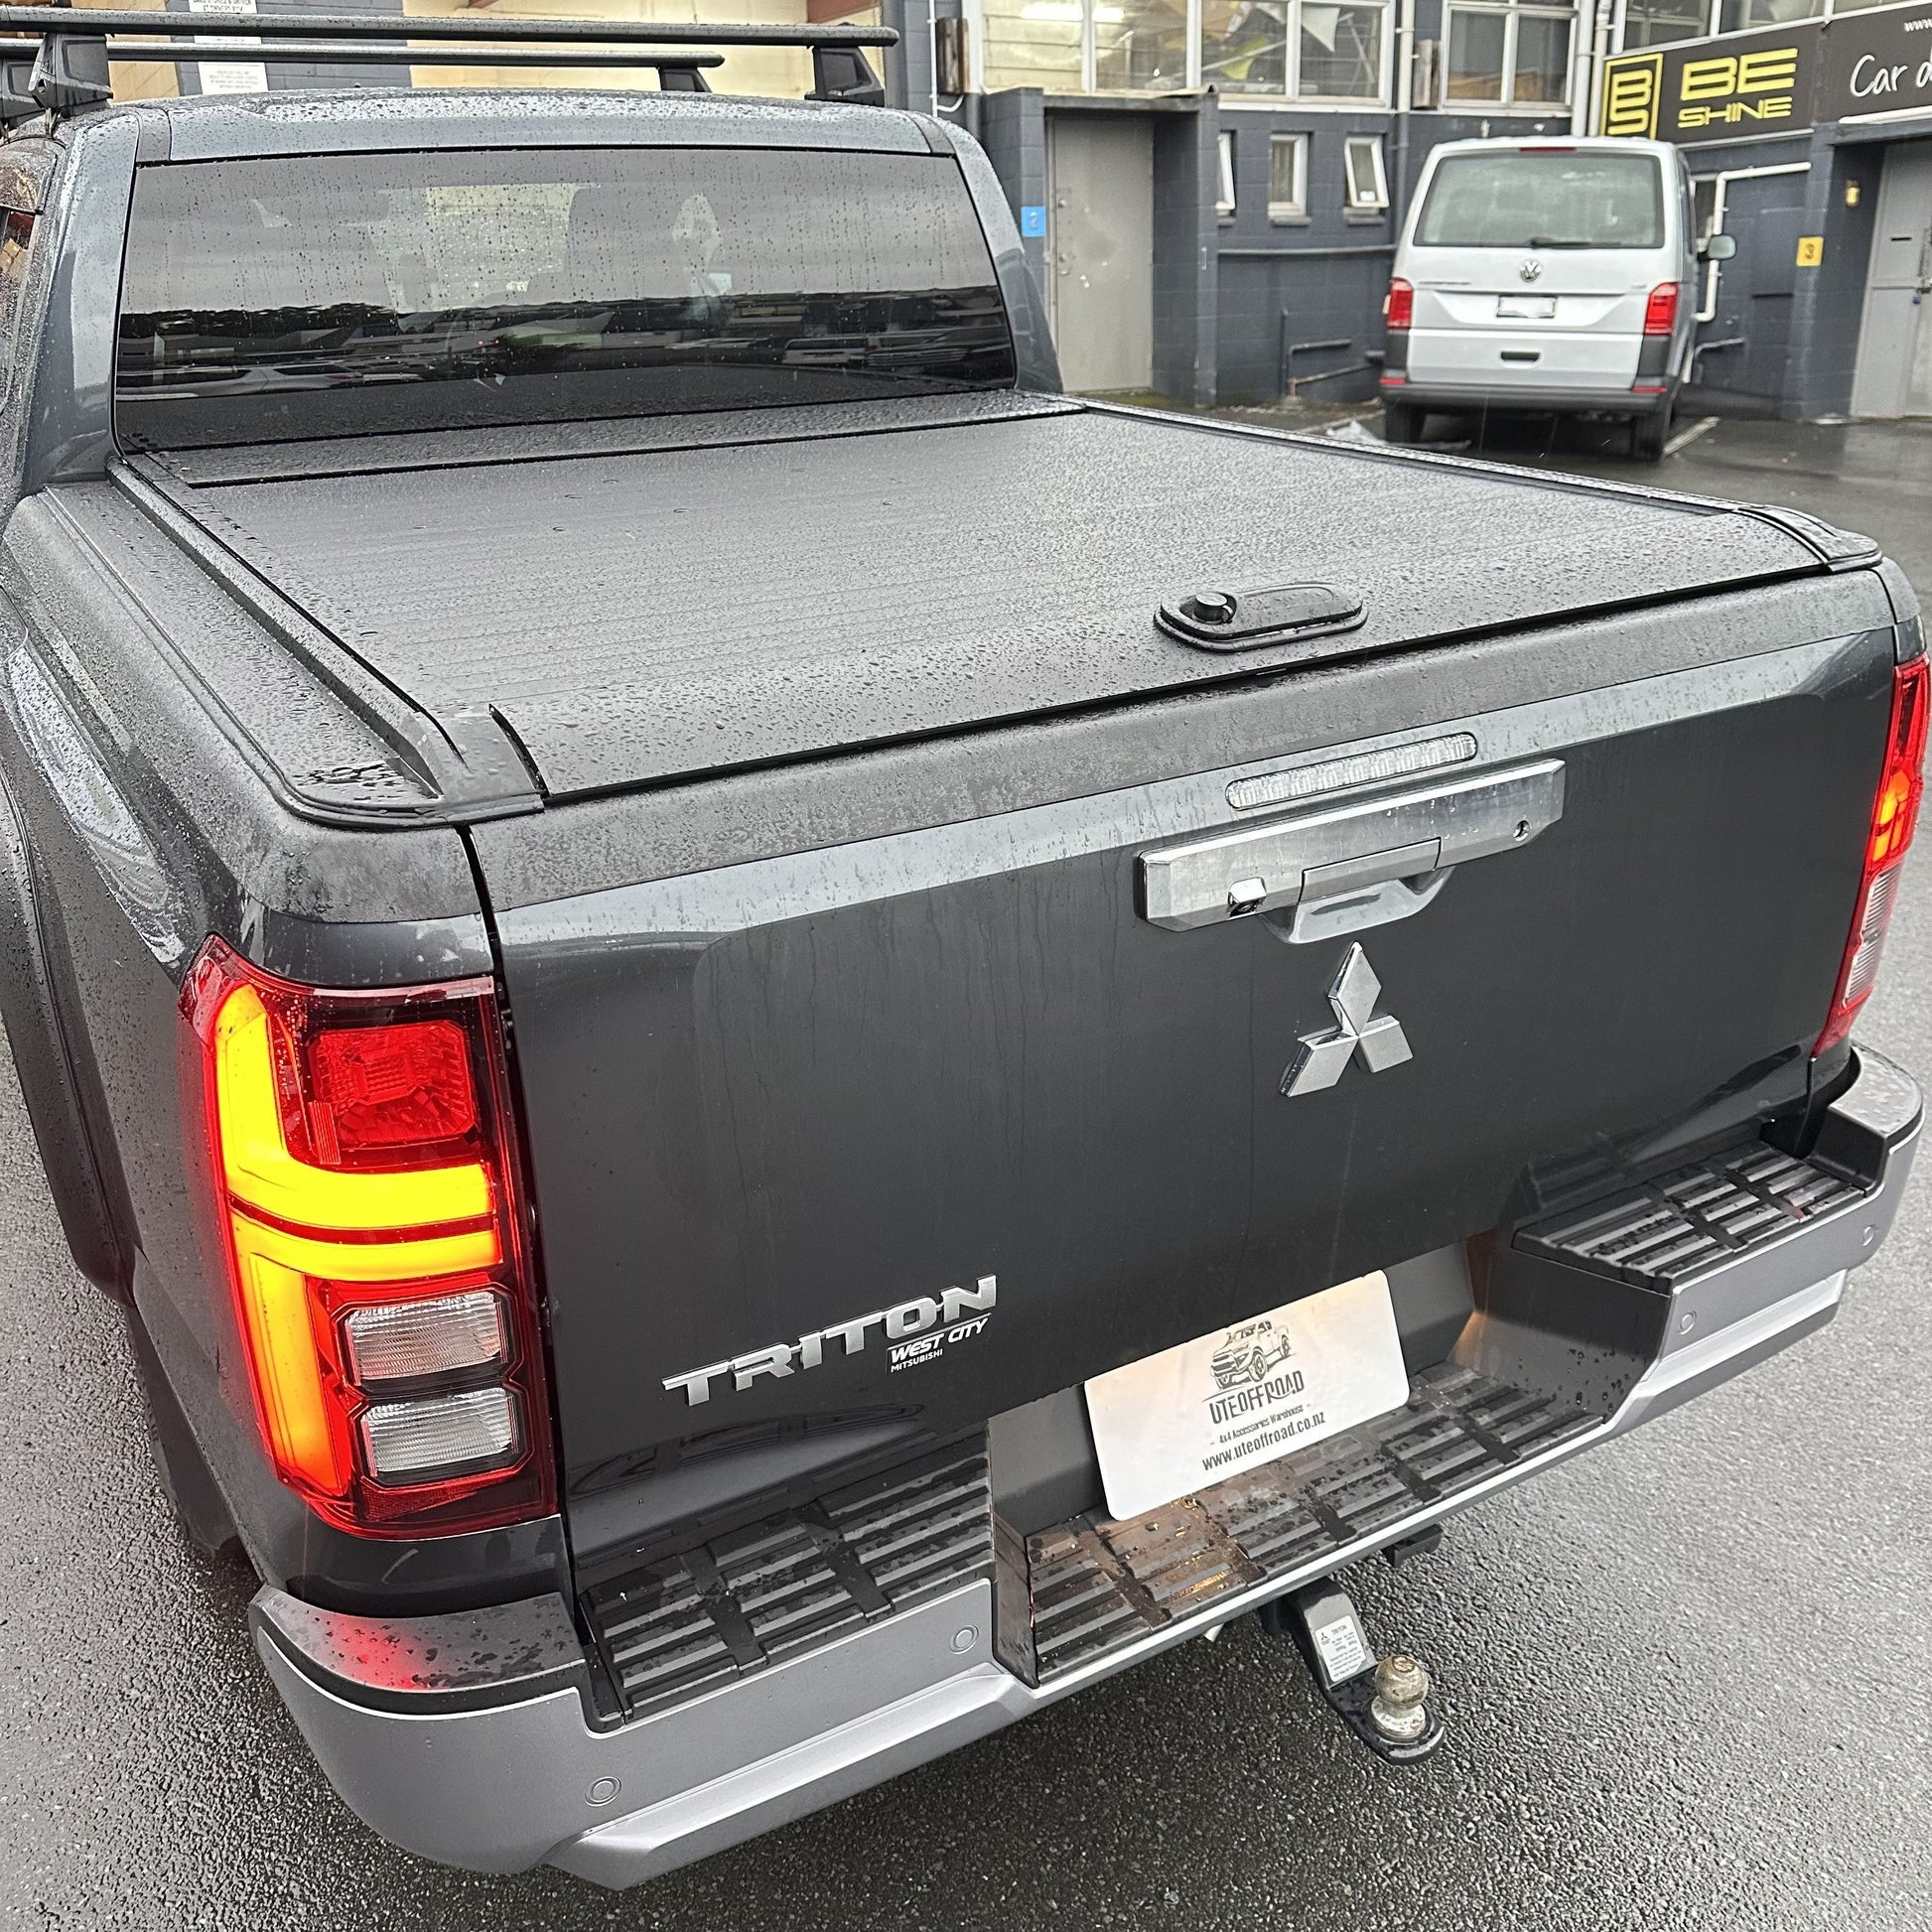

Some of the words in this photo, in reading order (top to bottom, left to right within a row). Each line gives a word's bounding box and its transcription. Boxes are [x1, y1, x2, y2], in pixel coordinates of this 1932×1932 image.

[1680, 48, 1798, 101] BE
[1850, 54, 1908, 97] Car
[1678, 96, 1792, 128] SHINE
[1804, 243, 1815, 259] 3
[661, 1274, 998, 1406] TRITON
[891, 1333, 944, 1363] WEST
[948, 1317, 989, 1343] CITY
[891, 1348, 943, 1373] MITSUBISHI
[1202, 1412, 1326, 1471] www.uteoffroad.co.nz
[1219, 1432, 1232, 1445] 4x4
[1232, 1418, 1270, 1440] Accessories
[1270, 1405, 1305, 1424] Warehouse
